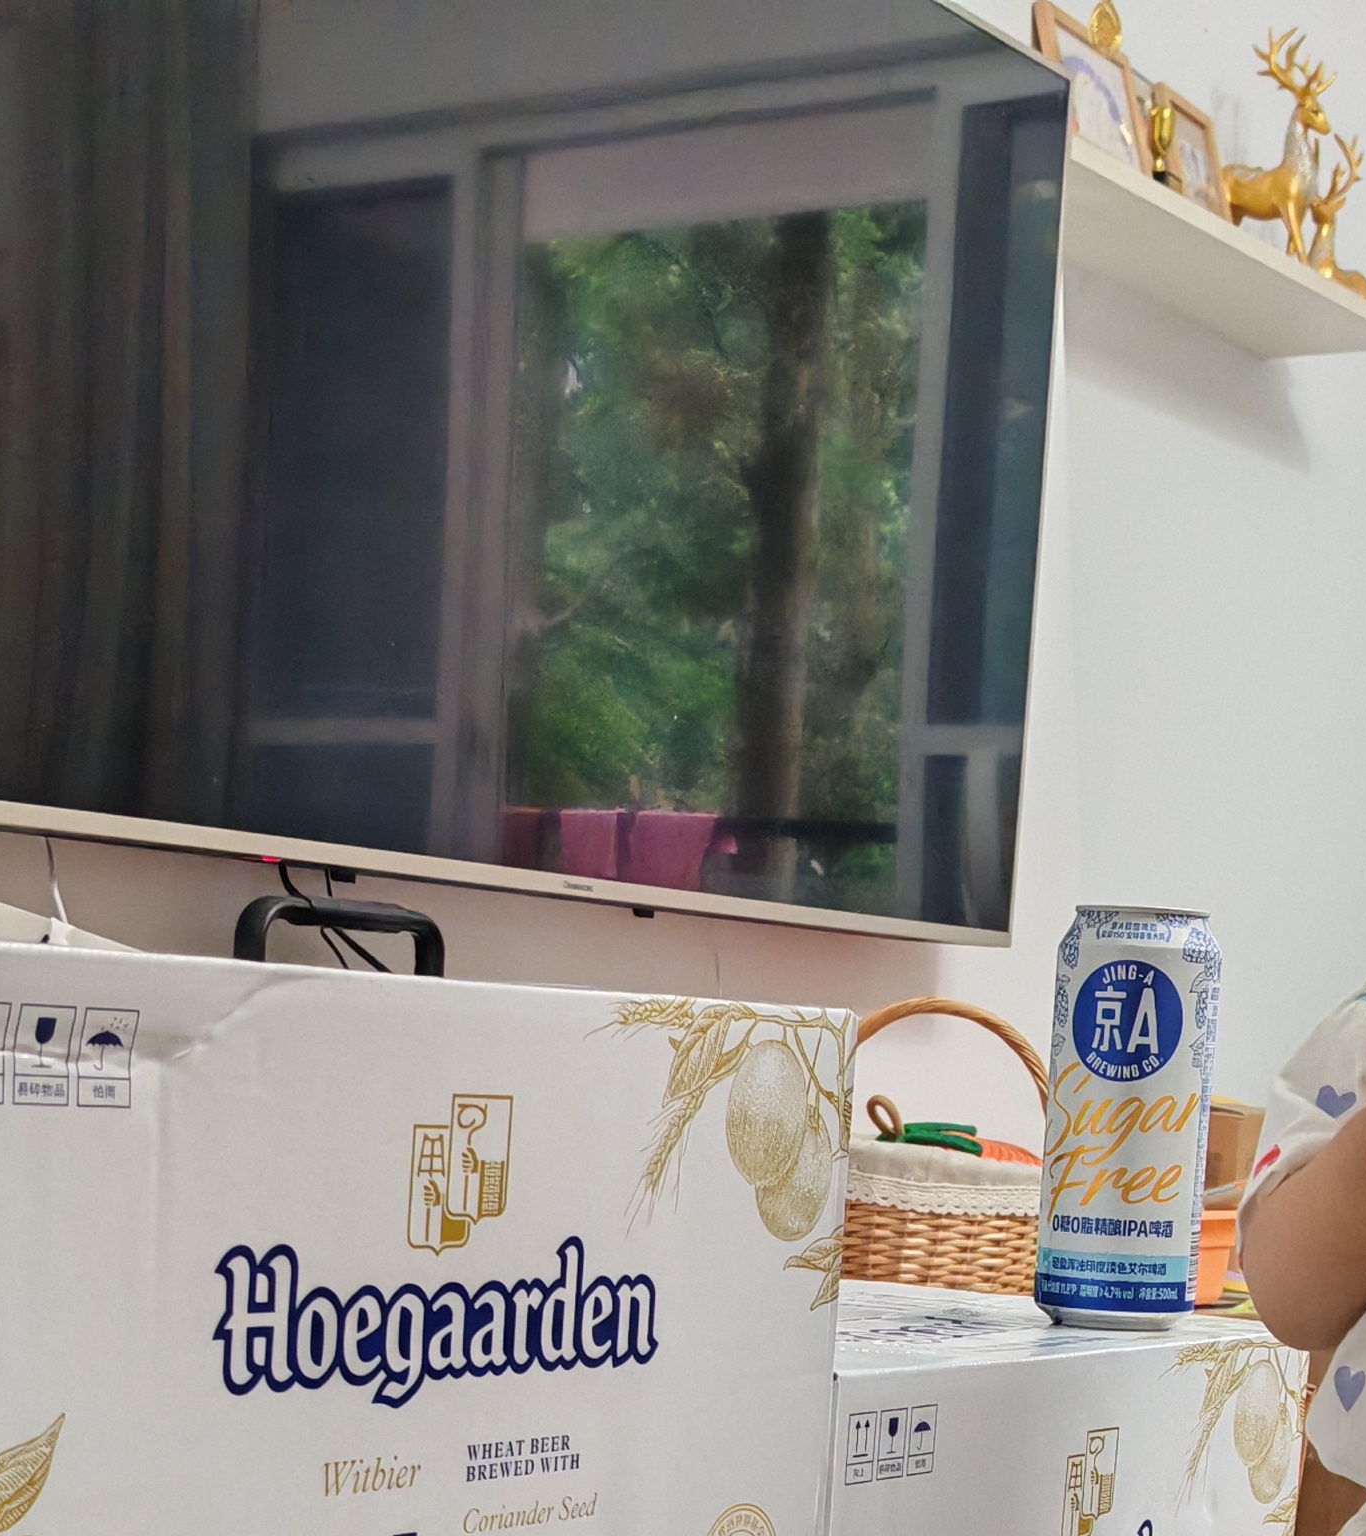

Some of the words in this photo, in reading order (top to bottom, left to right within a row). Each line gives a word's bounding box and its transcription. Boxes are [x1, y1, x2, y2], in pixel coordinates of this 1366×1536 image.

[1102, 964, 1155, 986] JING-A
[1091, 985, 1159, 1054] 京A
[1086, 1051, 1140, 1079] BREWING
[18, 1082, 66, 1097] 易碎物品
[1046, 1061, 1198, 1166] Sugar
[1047, 1146, 1183, 1226] Free
[1052, 1214, 1174, 1239] 0糖0脂精酿IPA啤酒
[213, 1234, 658, 1409] Hoegaarden
[467, 1440, 525, 1462] WHEAT
[530, 1434, 571, 1456] BEER
[323, 1455, 422, 1498] Witbier
[465, 1459, 536, 1483] BREWED
[540, 1453, 581, 1475] WITH
[463, 1503, 555, 1535] Coriander
[558, 1492, 598, 1523] Seed
